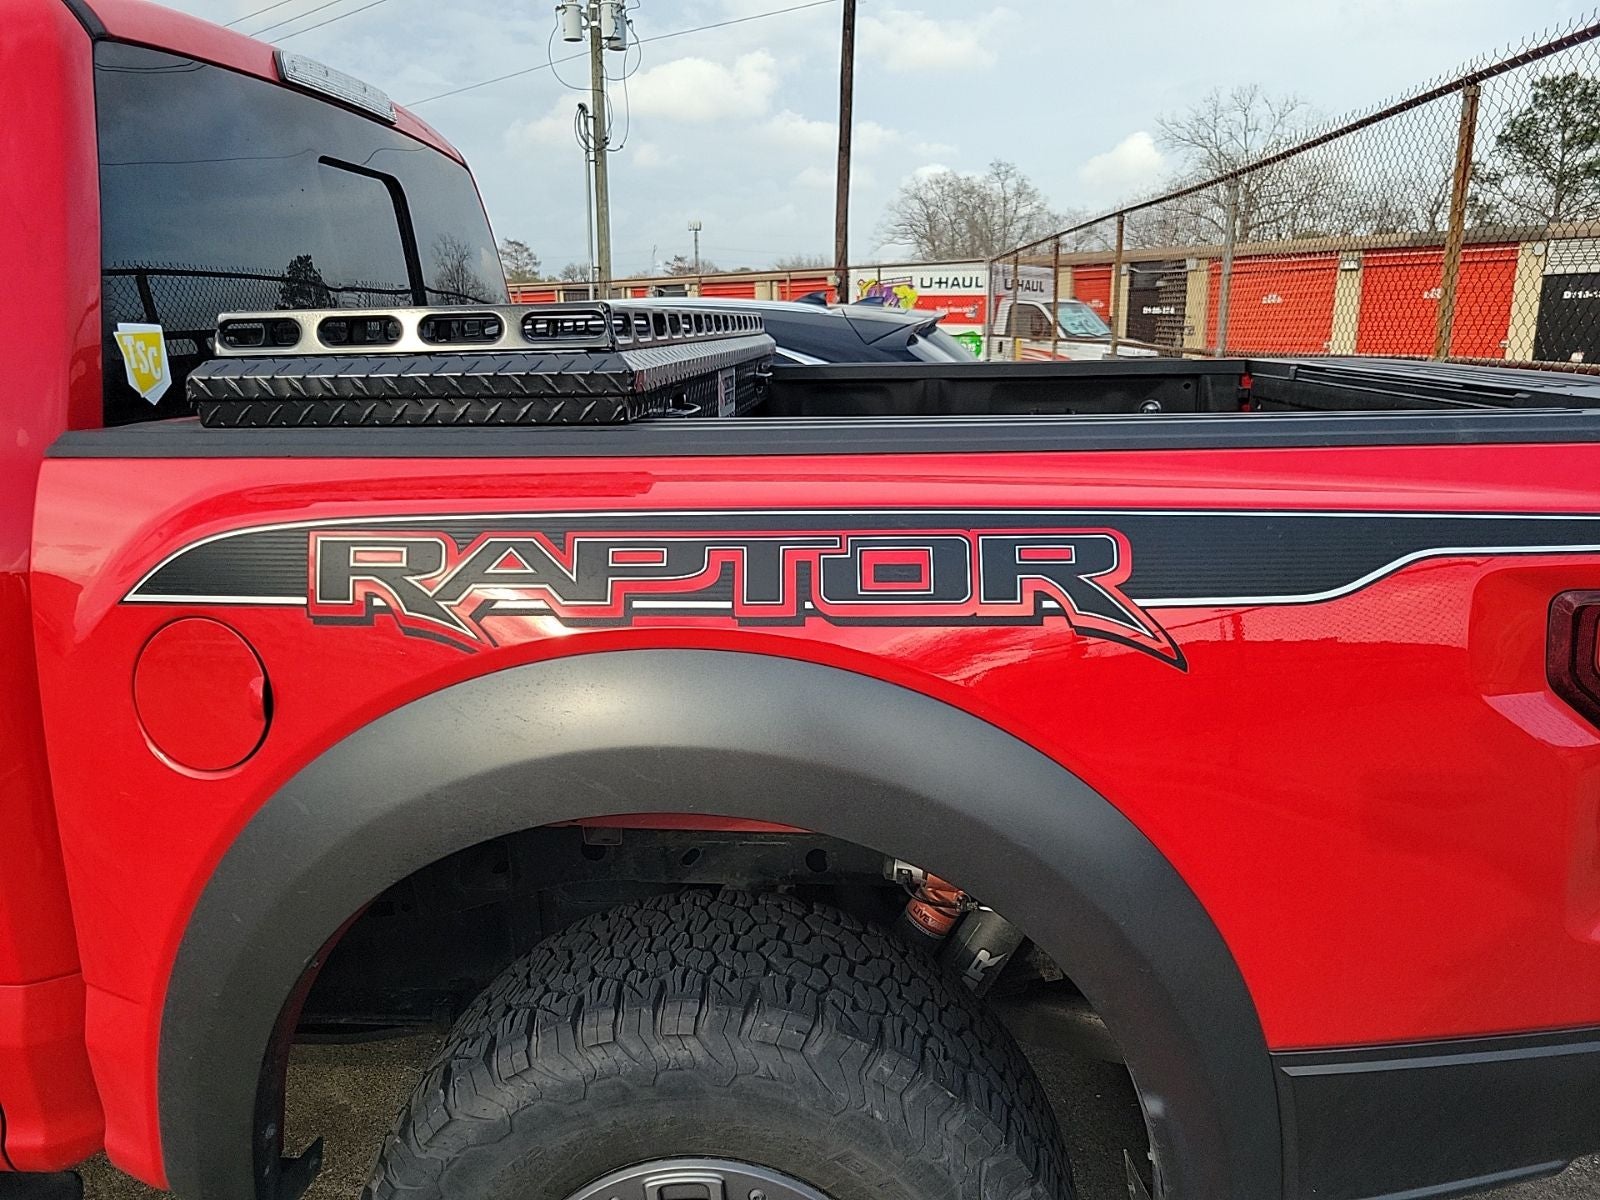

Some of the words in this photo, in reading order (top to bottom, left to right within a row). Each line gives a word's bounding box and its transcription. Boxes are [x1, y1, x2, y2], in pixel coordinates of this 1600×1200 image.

[920, 276, 984, 289] U-HAUL
[1004, 278, 1045, 293] UHAUL
[122, 335, 163, 381] TSC
[307, 529, 1189, 673] RAPTOR
